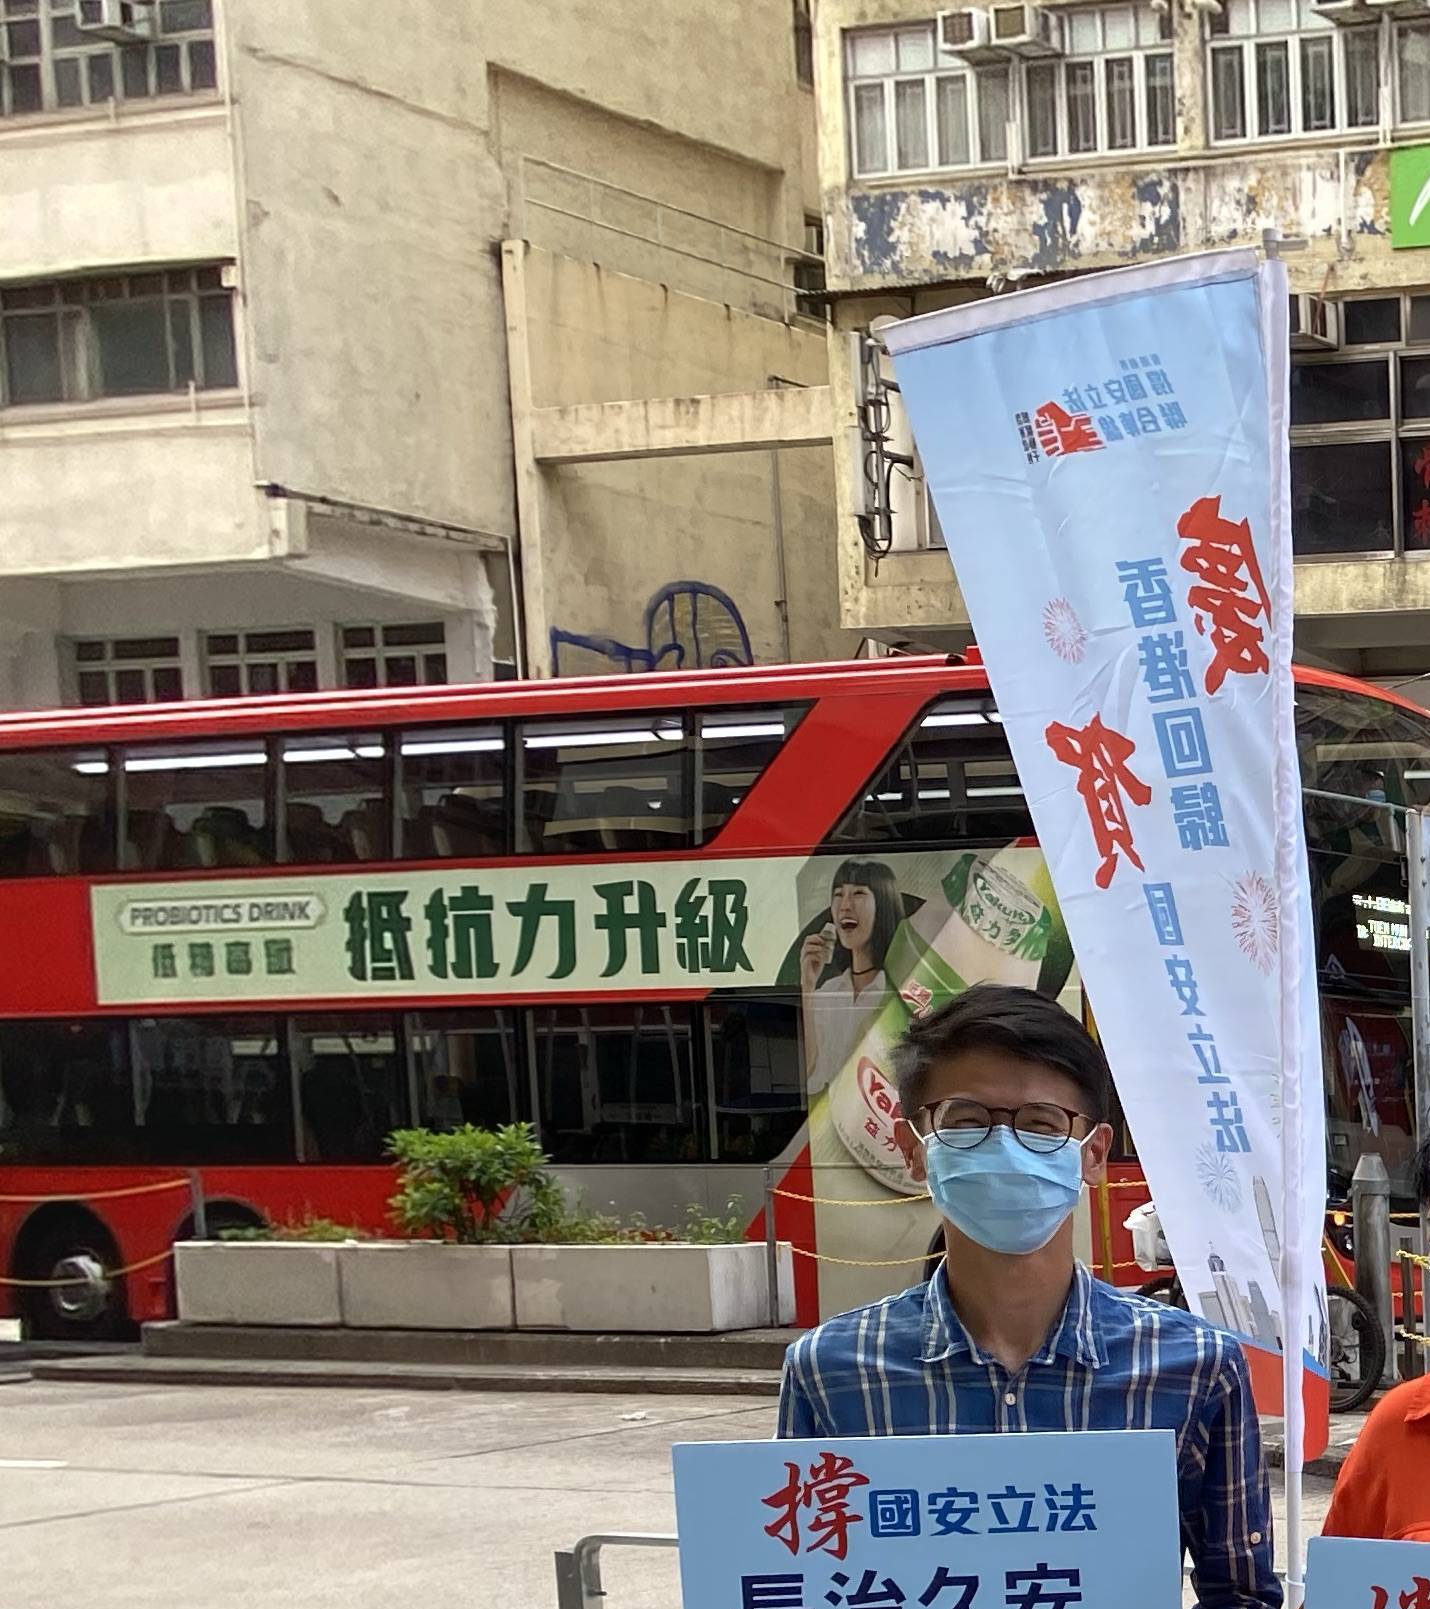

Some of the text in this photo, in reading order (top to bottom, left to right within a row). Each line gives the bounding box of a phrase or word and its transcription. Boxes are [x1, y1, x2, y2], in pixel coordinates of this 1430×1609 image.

[131, 901, 311, 927] PROBIOTICS DRINK
[342, 876, 756, 982] 抵抗力升級
[761, 1452, 1098, 1561] 撐國安立法
